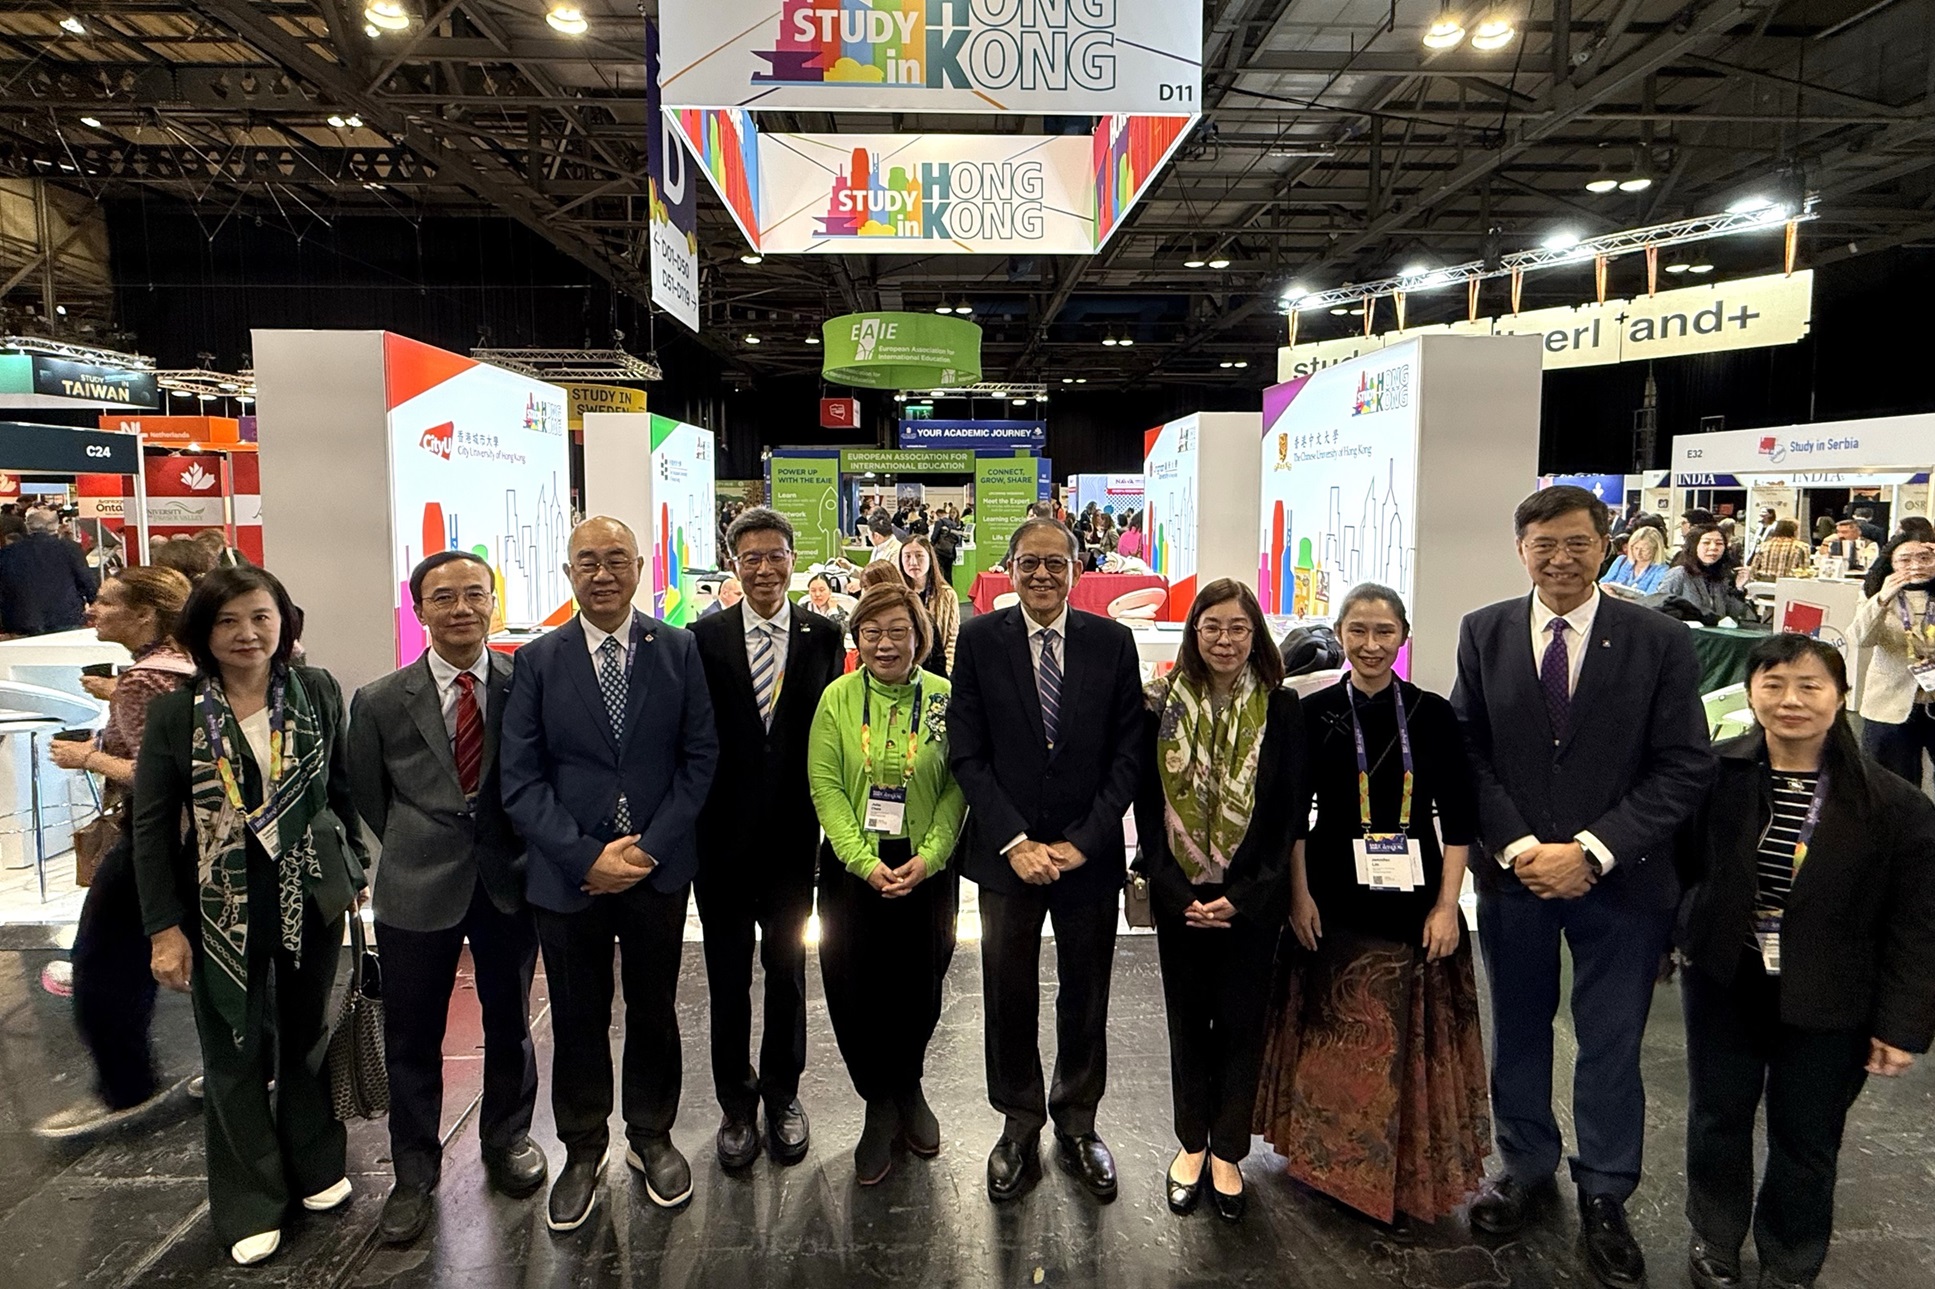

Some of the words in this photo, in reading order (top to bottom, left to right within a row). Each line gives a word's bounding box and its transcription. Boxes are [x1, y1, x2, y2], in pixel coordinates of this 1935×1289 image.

[793, 8, 919, 44] STUDY
[886, 48, 920, 84] in
[925, 29, 1116, 91] KONG
[1158, 84, 1193, 102] D11
[921, 161, 1044, 200] HONG
[838, 190, 918, 212] STUDY
[897, 214, 919, 237] in
[921, 201, 1044, 240] KONG
[851, 322, 898, 341] EAIE
[878, 345, 910, 353] European
[911, 346, 946, 355] Association
[878, 353, 920, 361] International
[920, 355, 951, 363] Education
[80, 374, 104, 384] STUDY
[61, 380, 130, 402] TAIWAN
[572, 388, 616, 403] STUDY
[619, 392, 632, 404] IN
[917, 429, 942, 437] YOUR
[943, 429, 989, 438] ACADEMIC
[990, 429, 1032, 438] JOURNEY
[85, 445, 112, 458] C24
[423, 434, 452, 457] CityU
[457, 445, 470, 459] City
[1790, 440, 1814, 454] Study
[1815, 440, 1825, 451] in
[1827, 437, 1859, 451] Serbia
[847, 453, 892, 461] EUROPEAN
[894, 453, 949, 461] ASSOCIATION
[950, 453, 968, 461] FOR
[1687, 449, 1703, 459] E32
[777, 468, 806, 476] POWER
[808, 468, 818, 476] UP
[850, 462, 916, 470] INTERNATIONAL
[917, 462, 965, 470] EDUCATION
[987, 468, 1025, 477] CONNECT,
[778, 476, 798, 484] WITH
[799, 476, 815, 484] THE
[816, 476, 833, 485] EAIE
[981, 476, 1006, 485] GROW,
[1007, 476, 1033, 484] SHARE
[1677, 473, 1716, 486] INDIA
[1010, 497, 1030, 505] Expert
